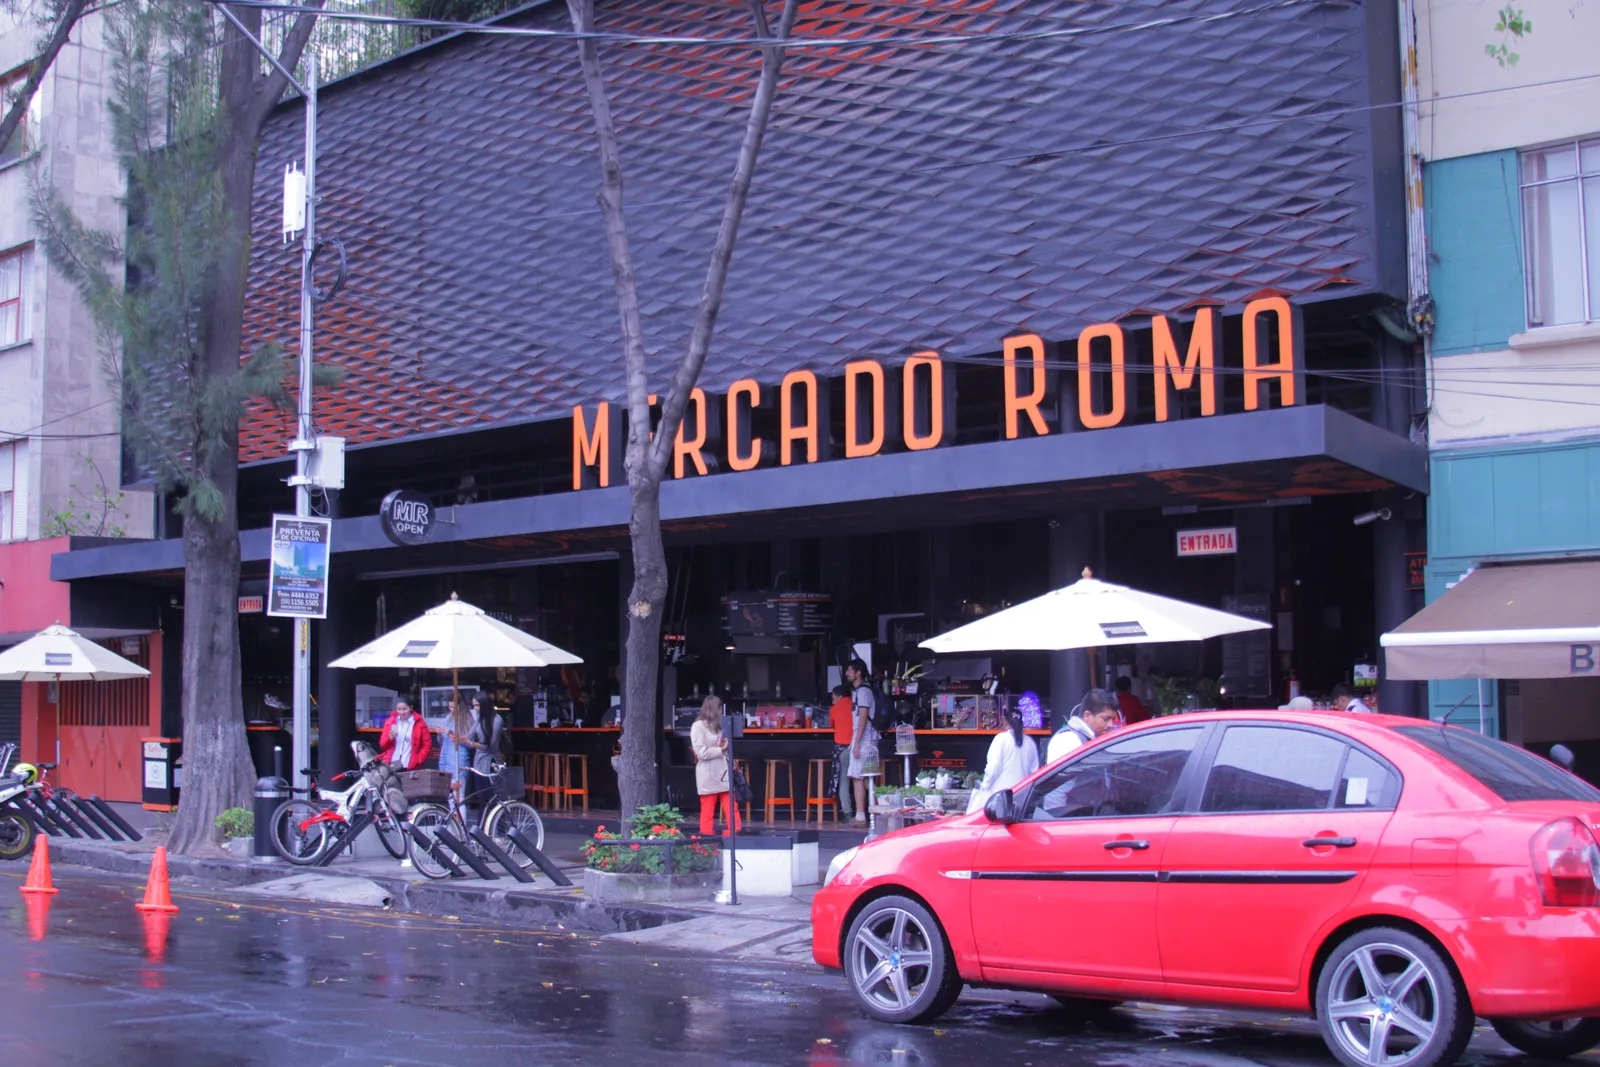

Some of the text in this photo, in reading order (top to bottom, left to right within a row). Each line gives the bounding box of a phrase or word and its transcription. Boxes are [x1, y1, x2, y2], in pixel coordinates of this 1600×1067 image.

[573, 296, 1295, 490] MRCADO ROMA
[393, 500, 428, 524] MR
[280, 527, 320, 538] PREVENTA
[396, 522, 424, 535] OPEN
[290, 535, 319, 543] OFICINAS
[1180, 532, 1233, 552] ENTRADA
[1571, 644, 1594, 672] B
